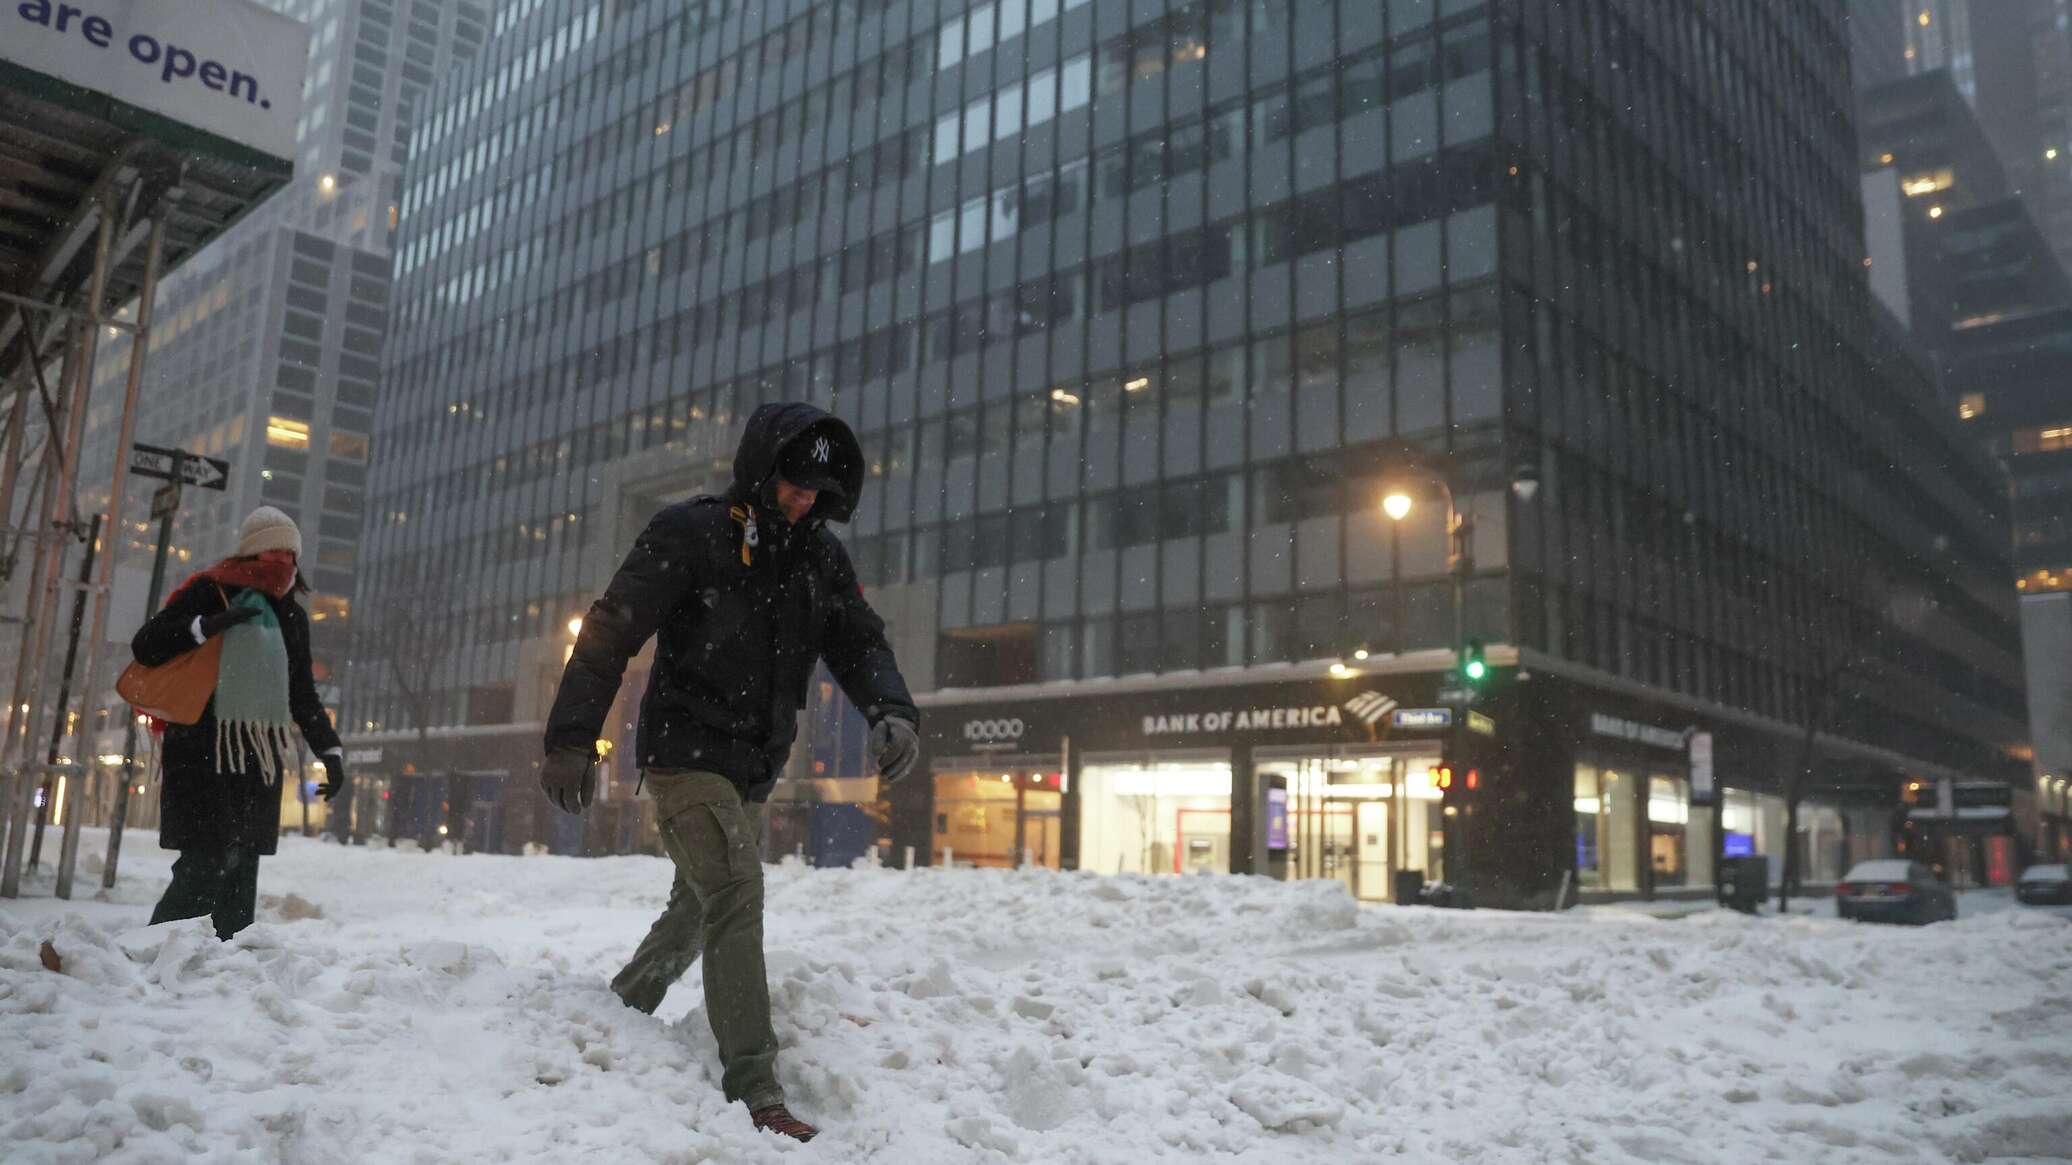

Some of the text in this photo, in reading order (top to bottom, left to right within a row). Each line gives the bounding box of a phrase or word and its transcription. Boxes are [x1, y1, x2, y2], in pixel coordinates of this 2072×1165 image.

[17, 0, 271, 110] are open.
[812, 436, 830, 463] NY
[135, 451, 209, 478] ONE WAY
[1142, 705, 1342, 734] BANK OF AMERICA
